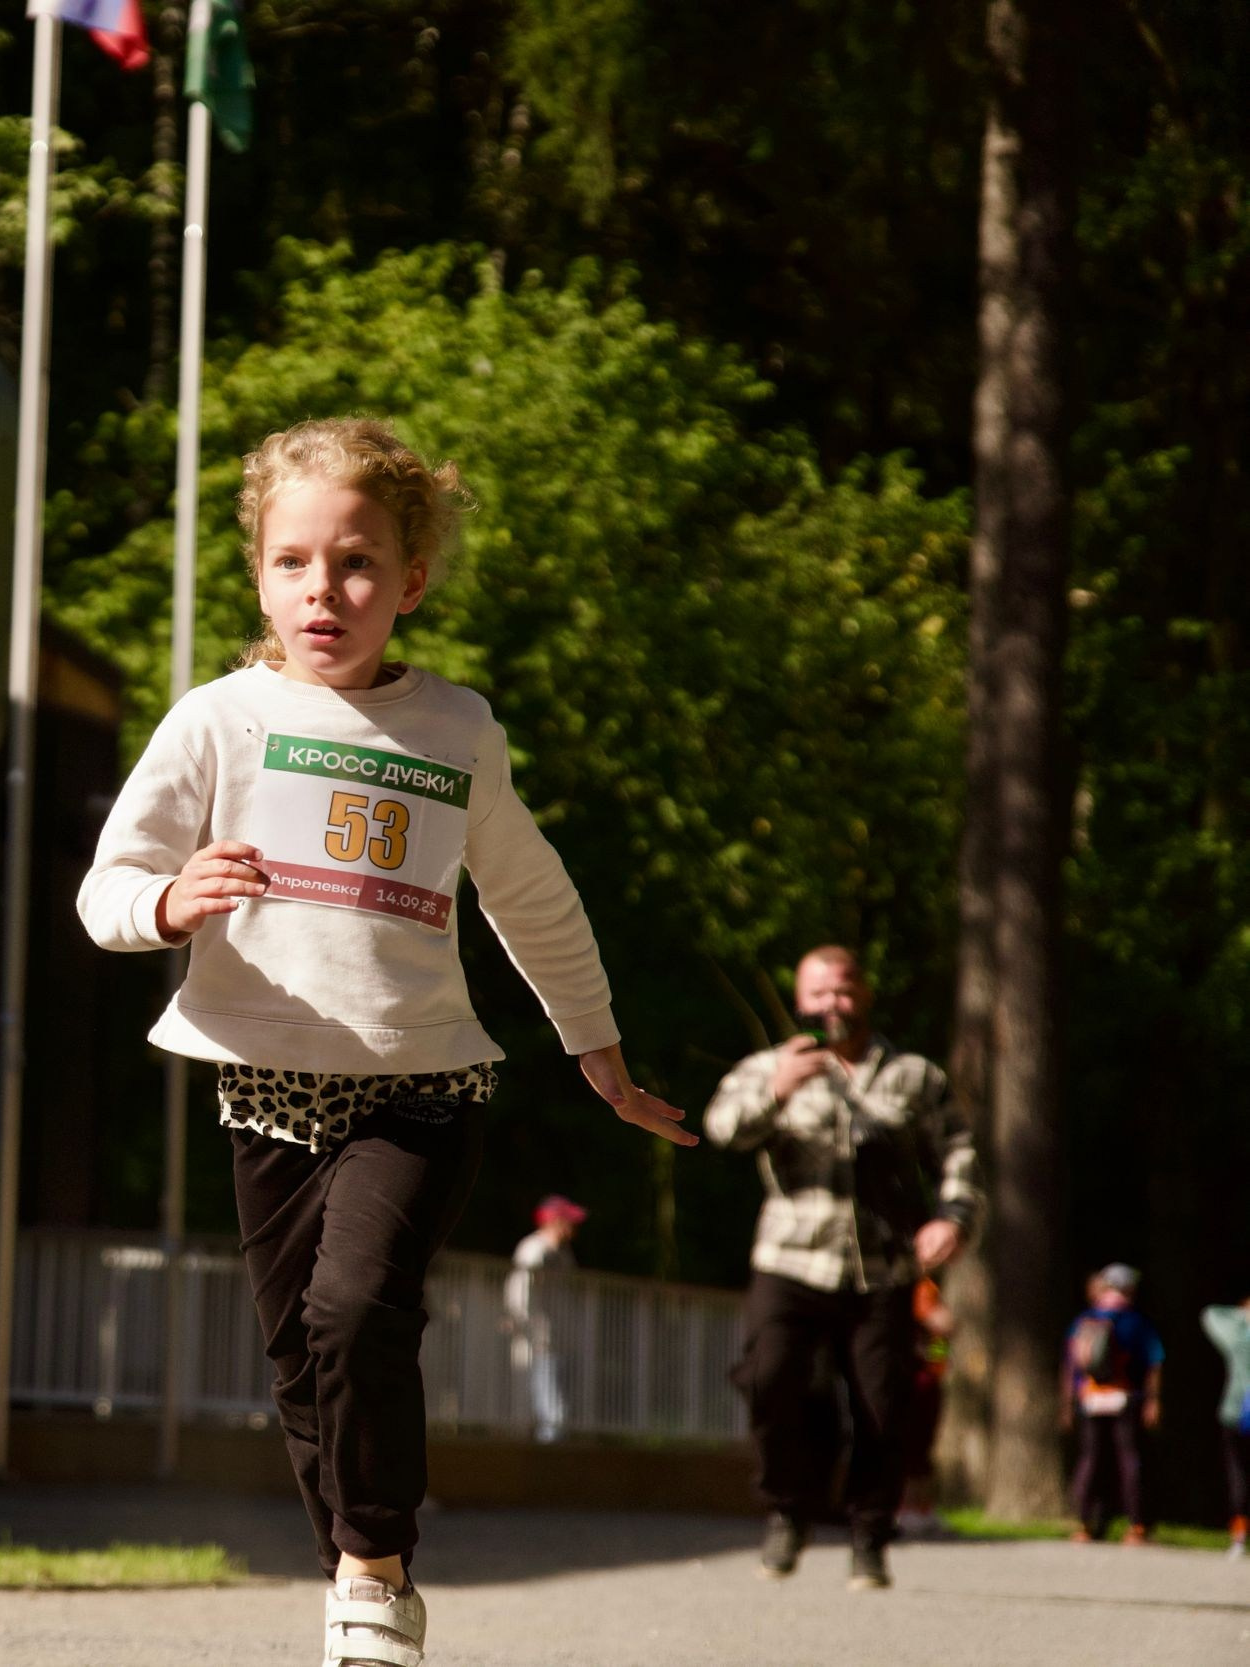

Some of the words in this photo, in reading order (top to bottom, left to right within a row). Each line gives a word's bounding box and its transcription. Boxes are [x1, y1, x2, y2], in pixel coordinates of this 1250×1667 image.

[287, 746, 378, 775] КРОСС
[381, 762, 455, 796] ДУБКИ
[324, 790, 410, 871] 53
[270, 872, 360, 897] Апрелевка
[376, 889, 437, 916] 14.09.25
